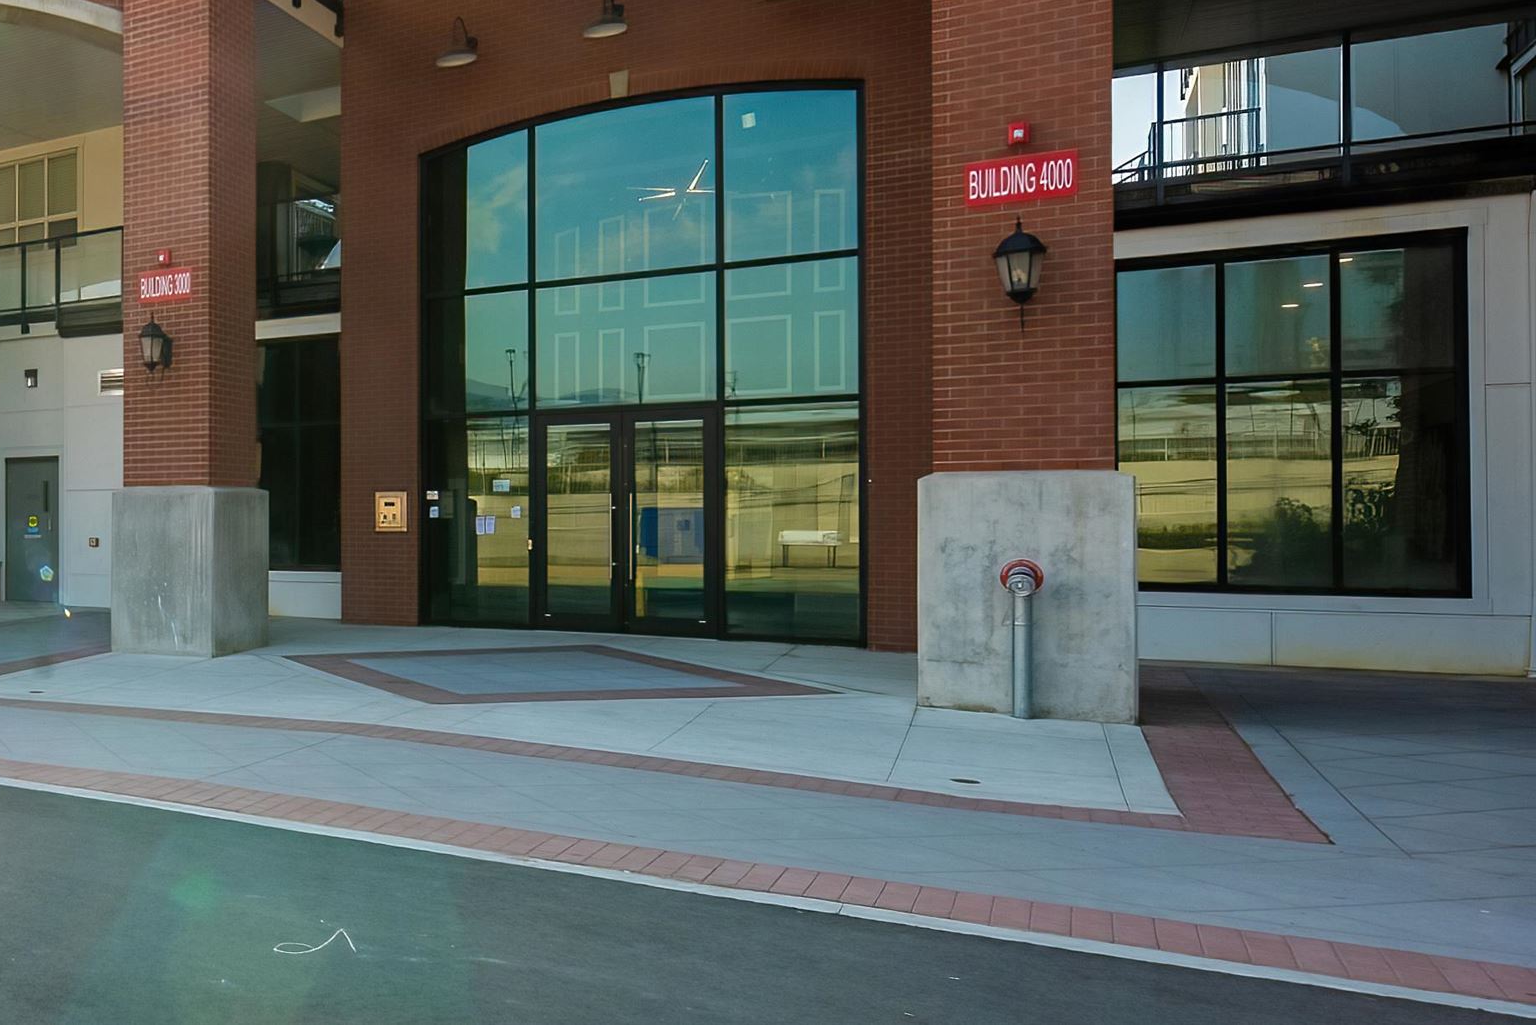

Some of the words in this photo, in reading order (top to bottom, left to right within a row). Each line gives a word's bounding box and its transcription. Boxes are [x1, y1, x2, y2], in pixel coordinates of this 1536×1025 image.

[969, 162, 1036, 200] BUILDING
[1039, 158, 1073, 191] 4000
[140, 275, 173, 299] BUILDING
[174, 272, 191, 295] 3000
